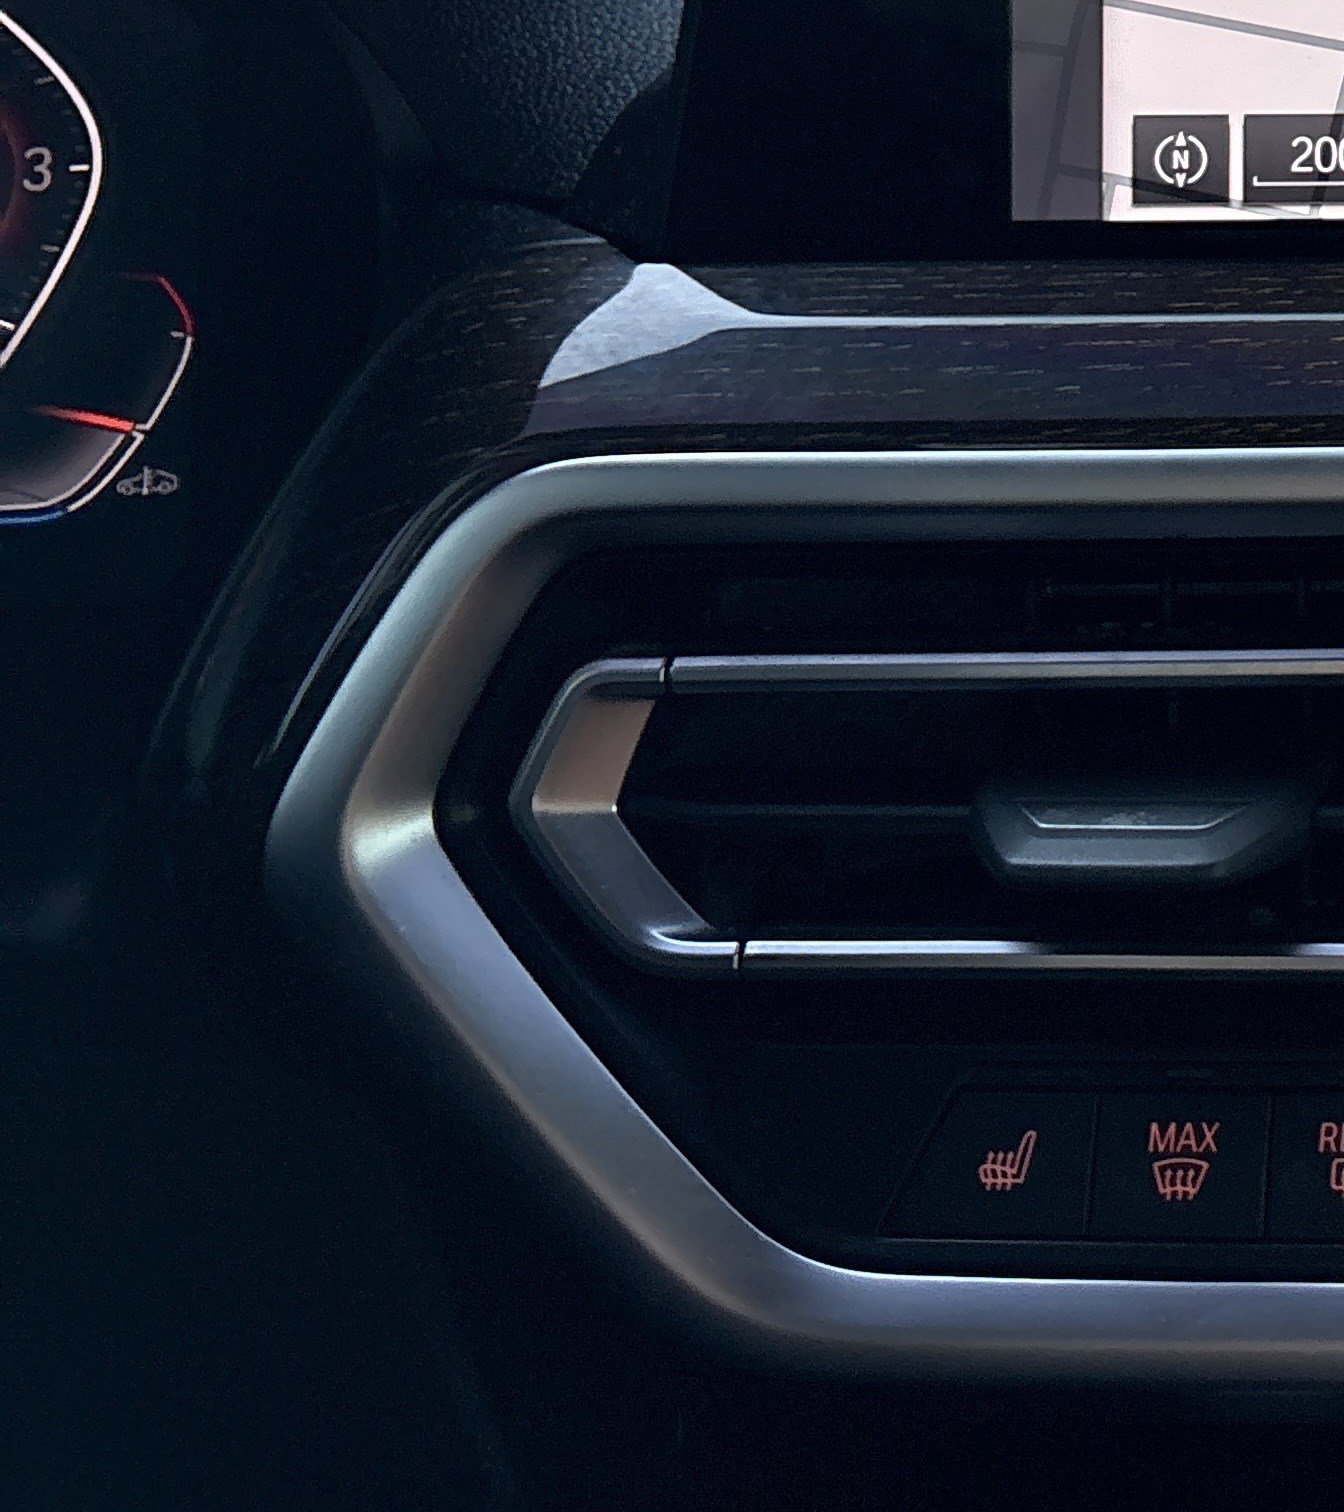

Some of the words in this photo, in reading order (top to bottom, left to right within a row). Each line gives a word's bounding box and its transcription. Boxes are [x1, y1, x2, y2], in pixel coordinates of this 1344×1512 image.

[22, 146, 53, 193] 3
[1174, 150, 1189, 170] N
[1147, 1122, 1220, 1153] MAX
